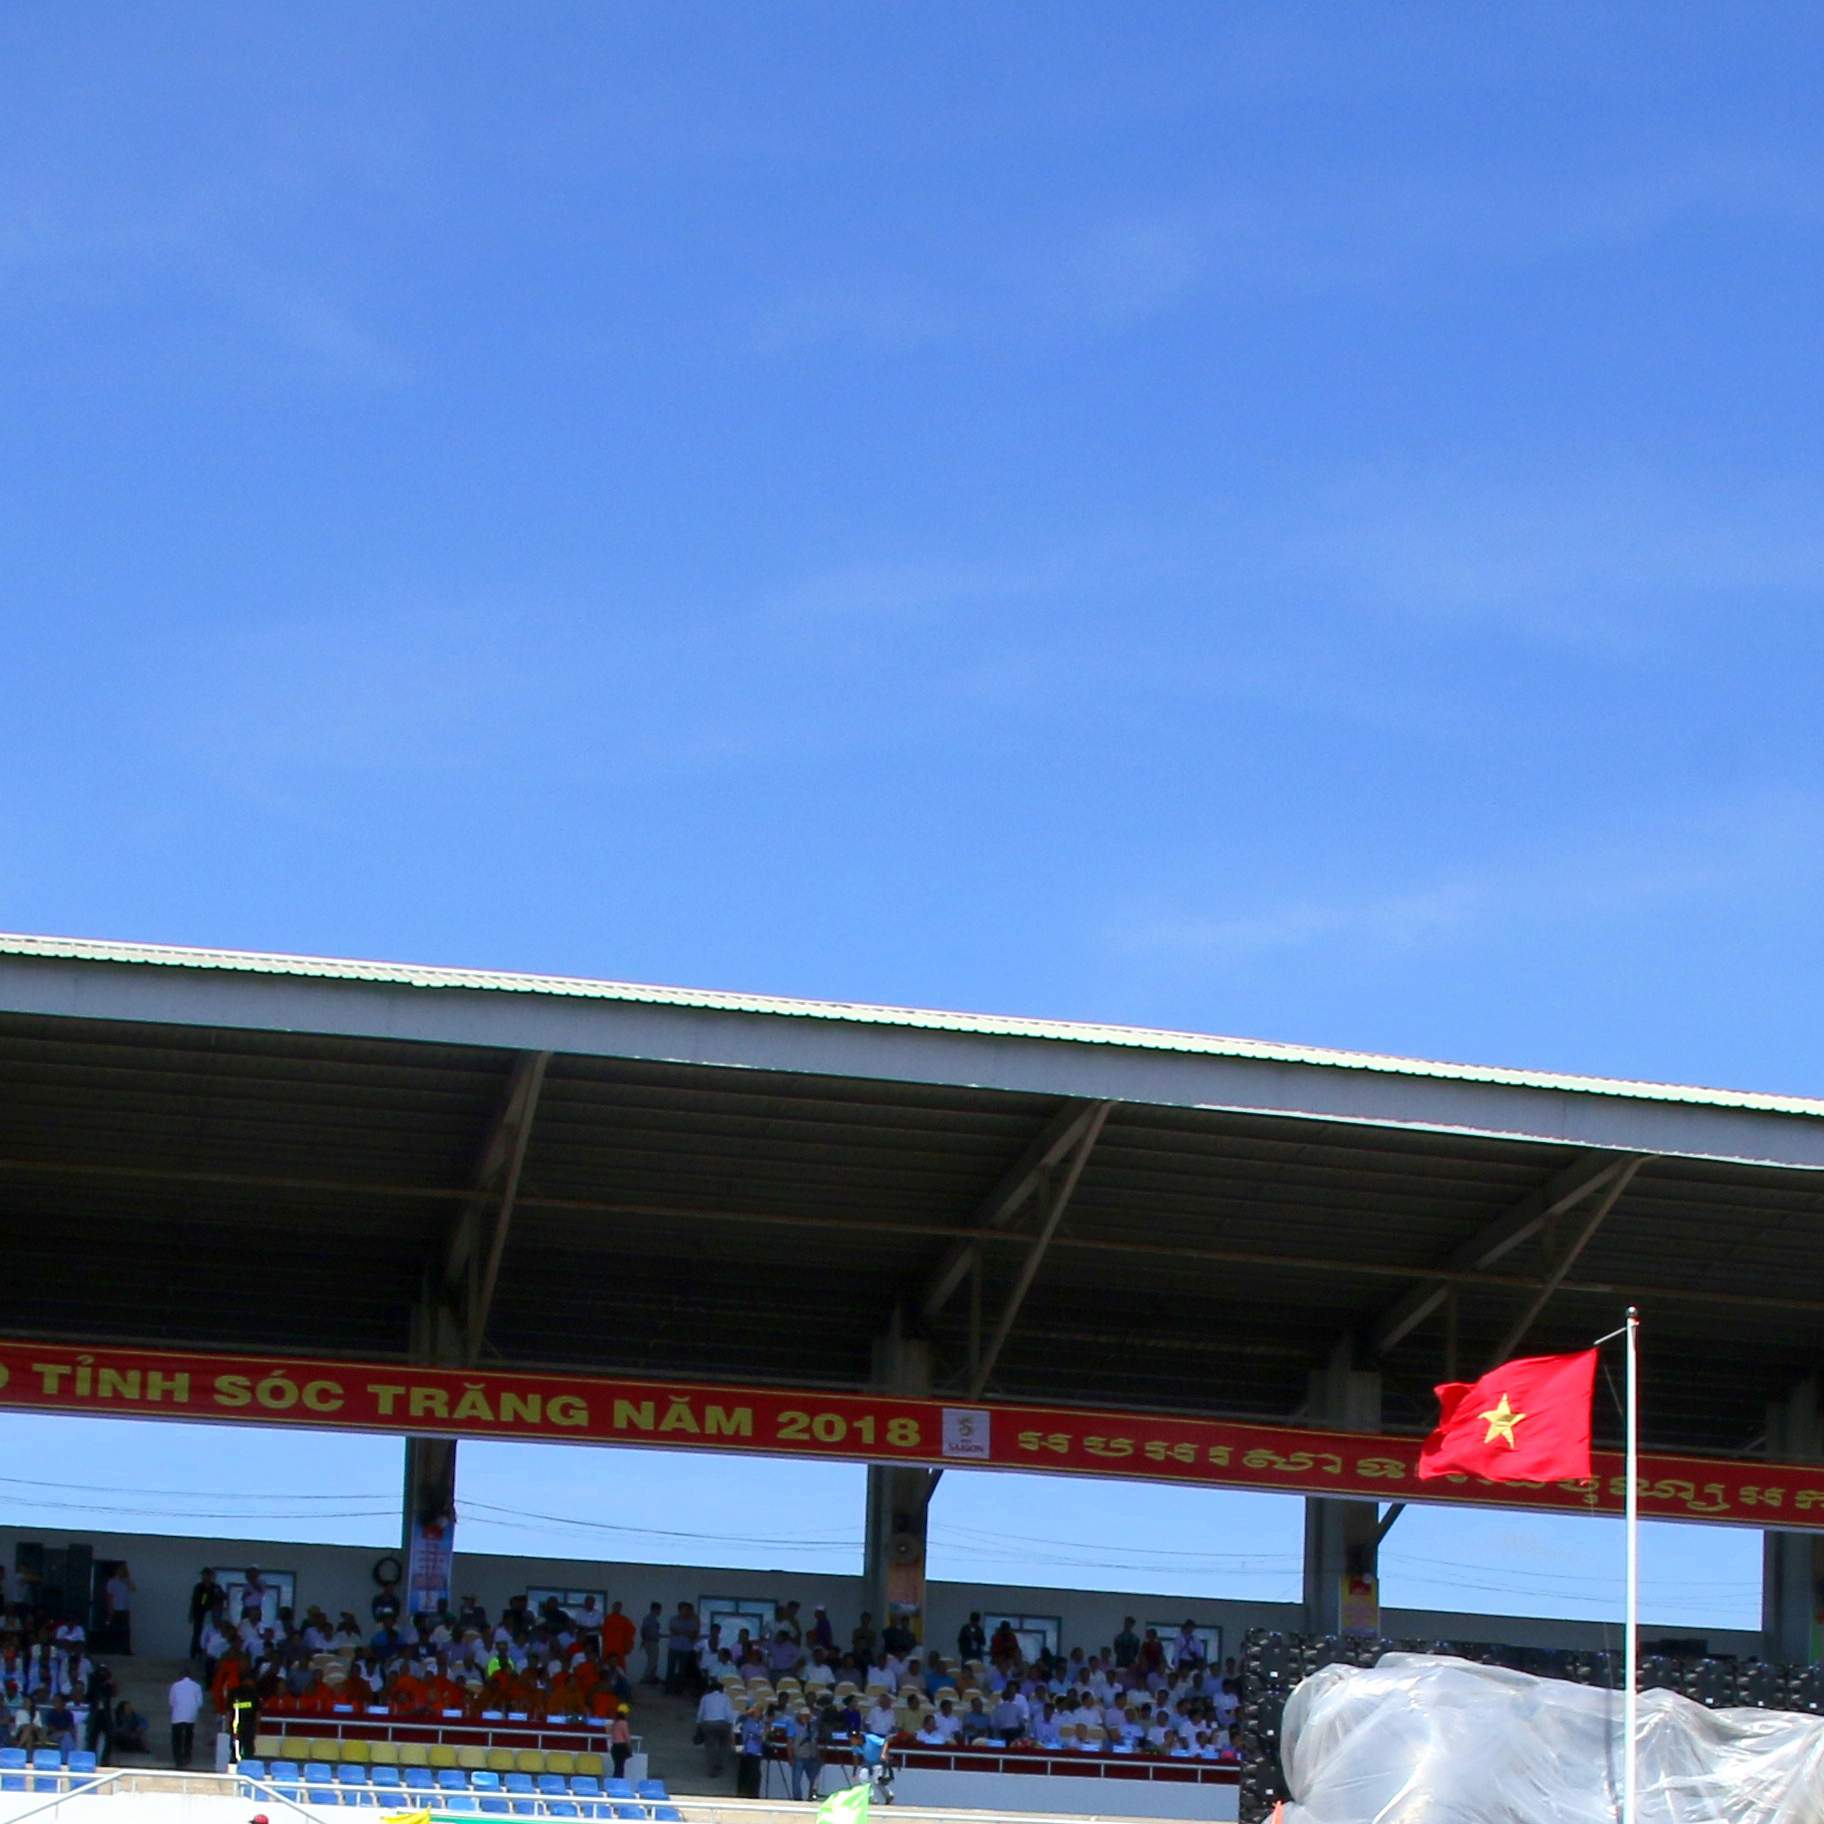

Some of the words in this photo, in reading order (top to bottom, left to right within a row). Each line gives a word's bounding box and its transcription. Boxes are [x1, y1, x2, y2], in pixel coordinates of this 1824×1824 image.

[32, 1355, 191, 1403] TỈNH
[213, 1368, 346, 1413] SÓC
[367, 1381, 590, 1428] TRĂNG
[613, 1395, 753, 1437] NĂM
[776, 1411, 922, 1449] 2018
